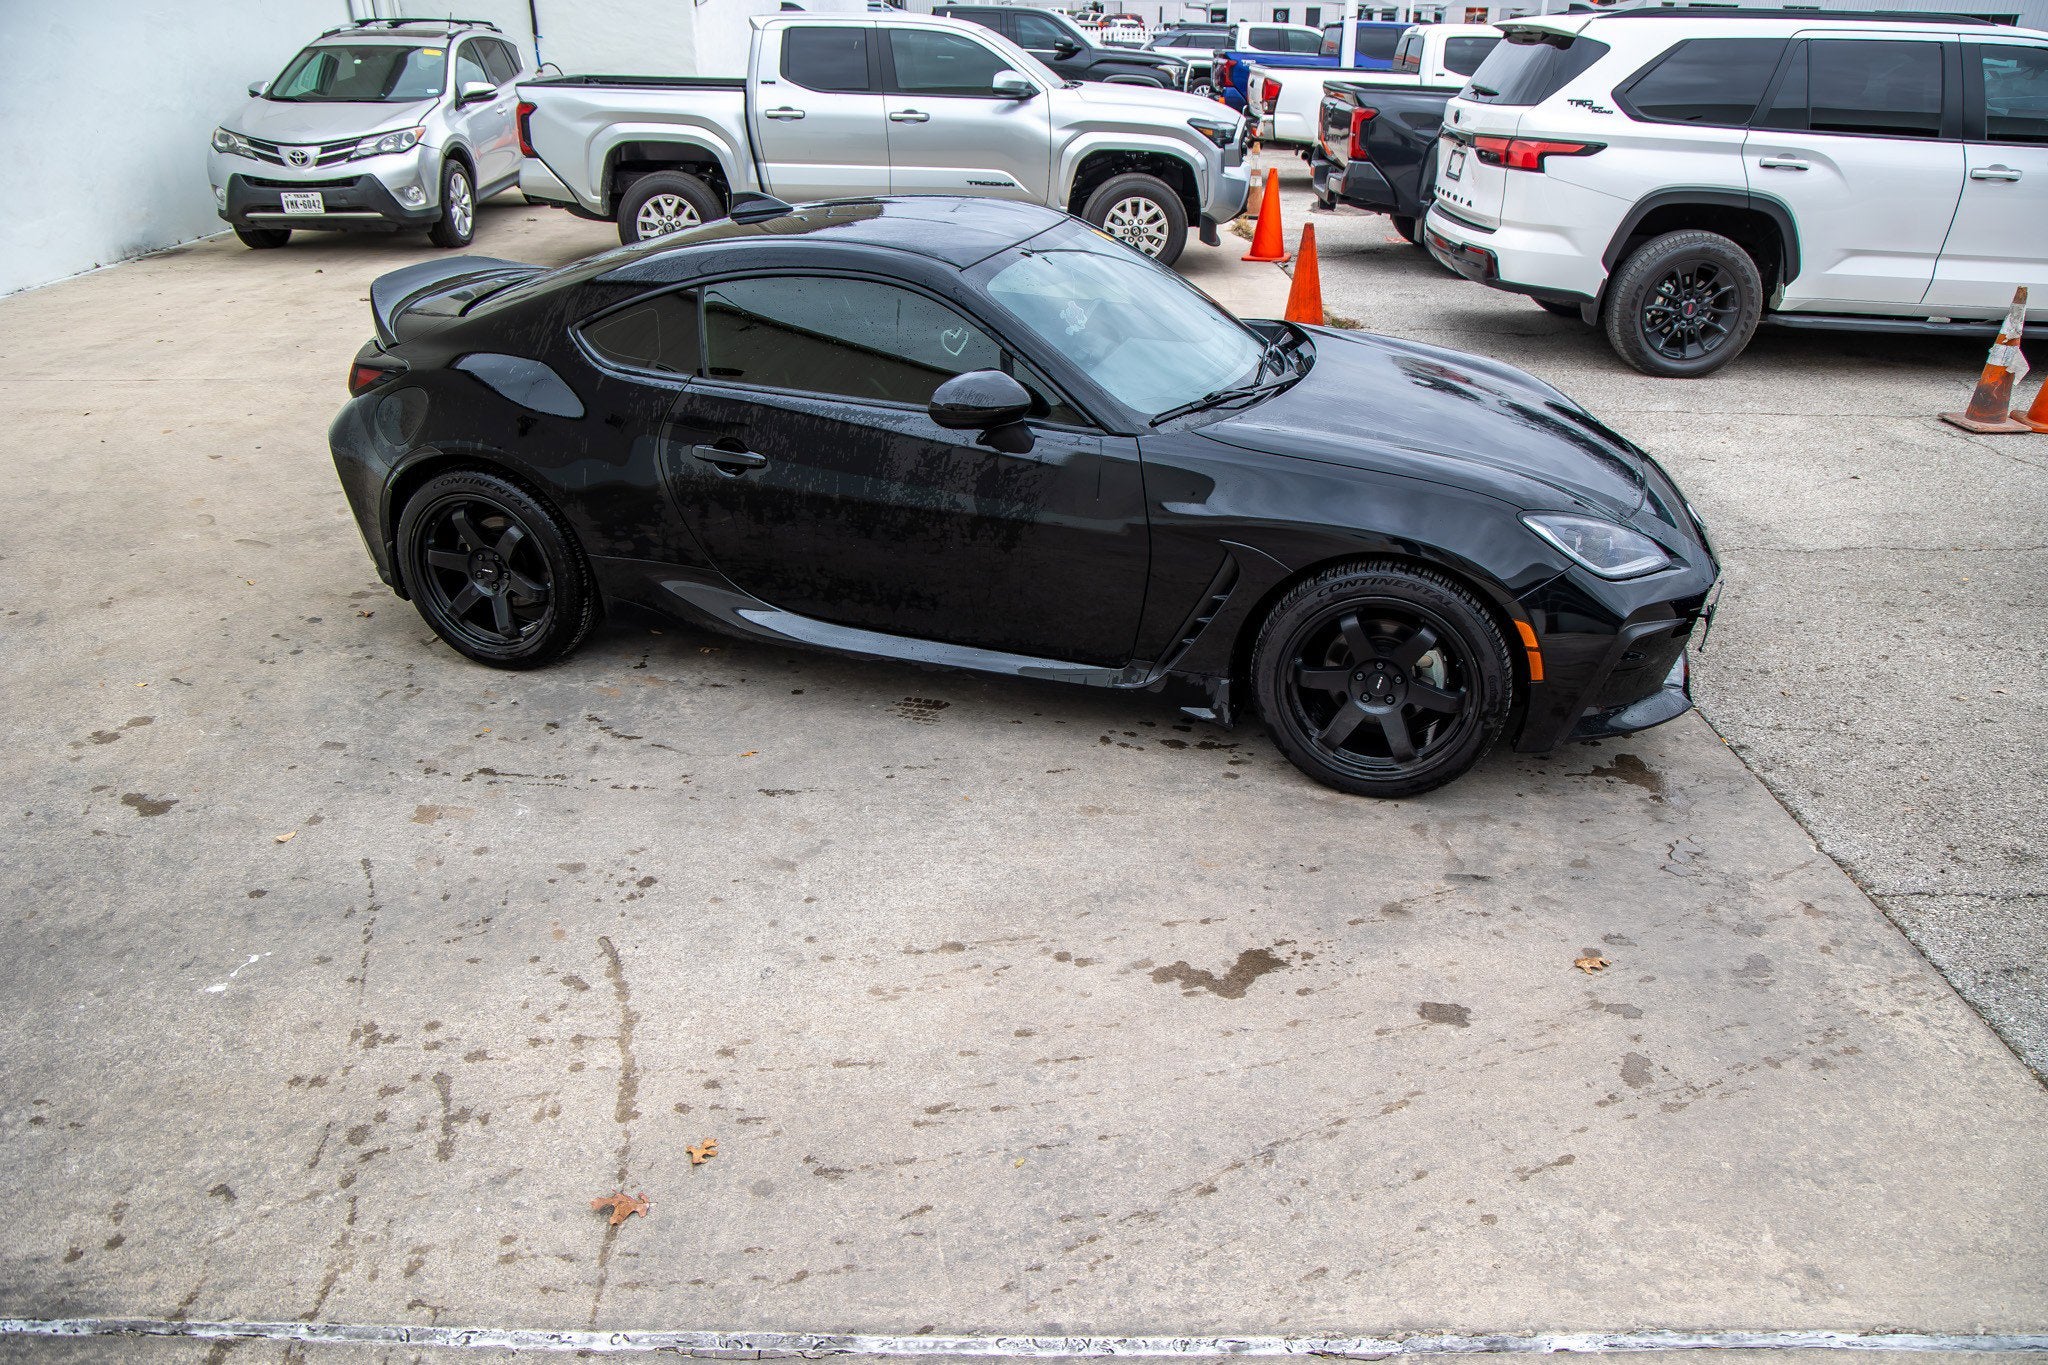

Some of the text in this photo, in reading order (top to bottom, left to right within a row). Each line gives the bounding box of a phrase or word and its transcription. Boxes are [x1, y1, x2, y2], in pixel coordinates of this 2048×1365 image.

[1567, 99, 1593, 107] TRD
[433, 476, 532, 512] CONTINENTAL
[1318, 578, 1453, 606] CONTINENTAL
